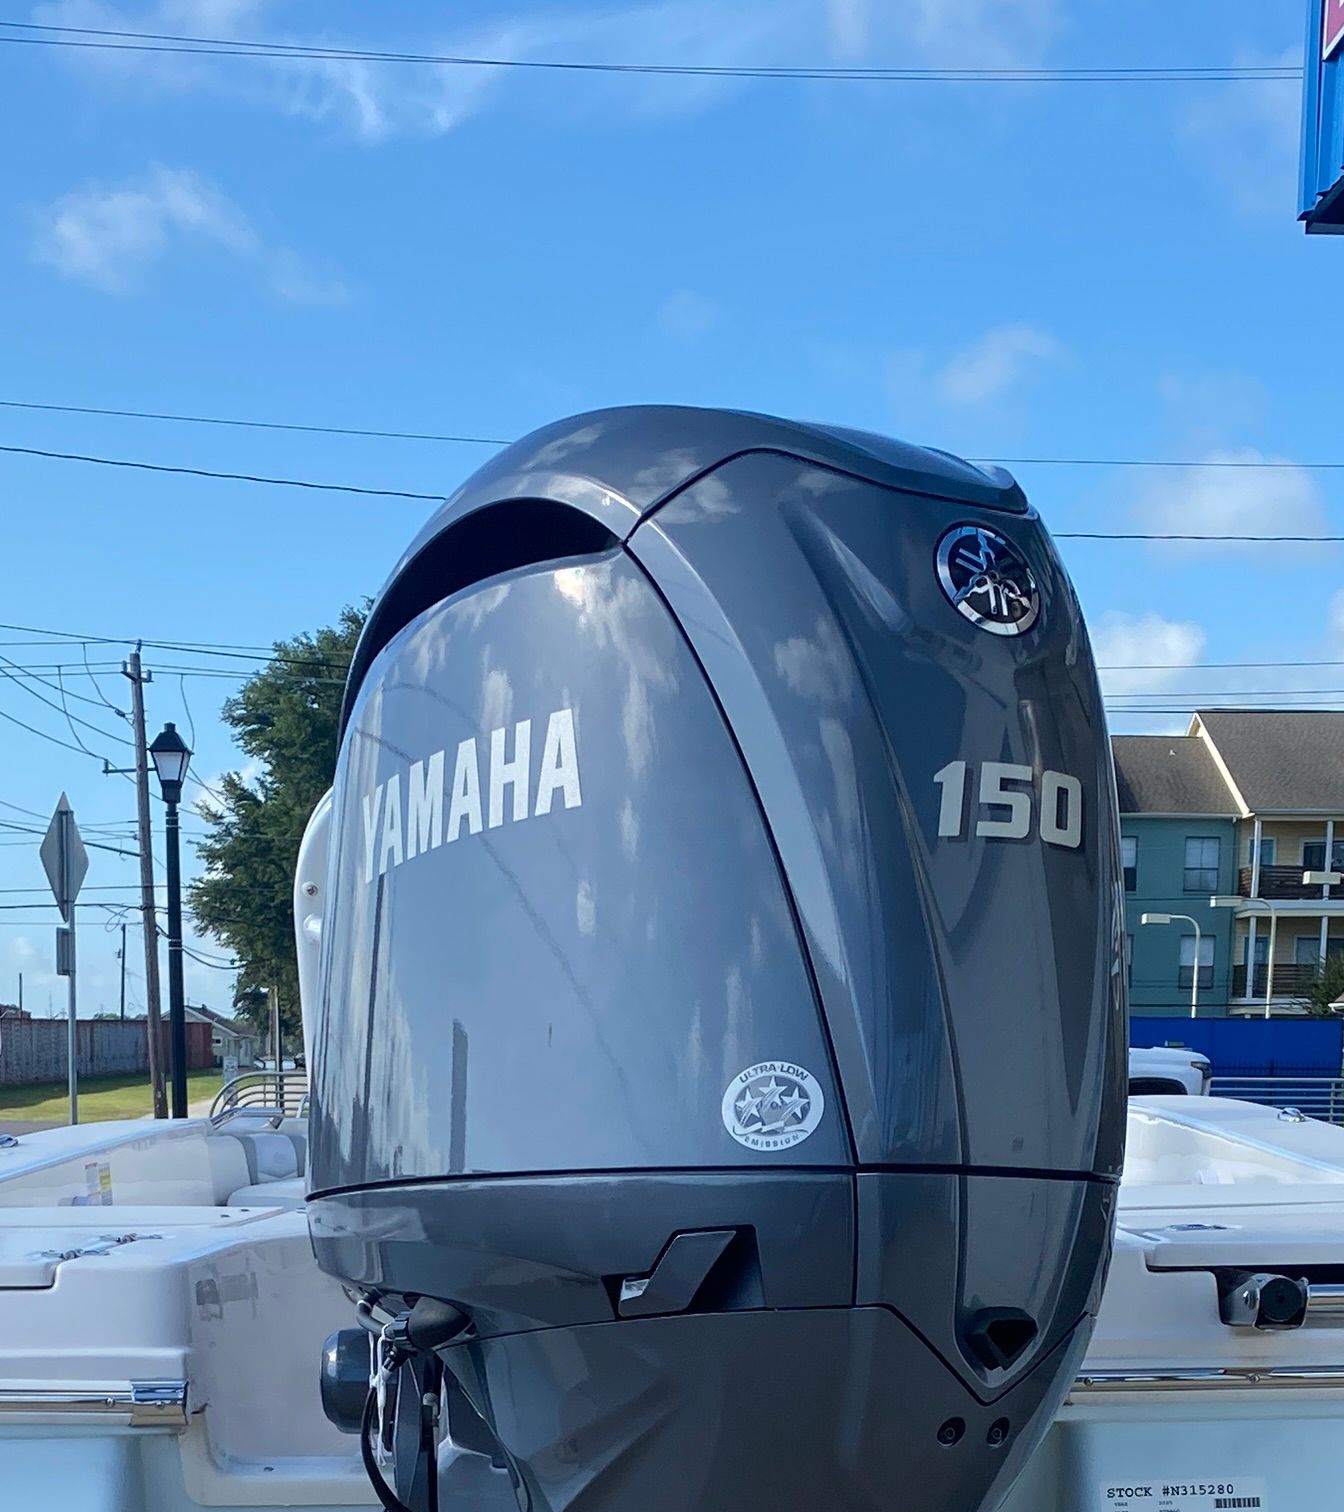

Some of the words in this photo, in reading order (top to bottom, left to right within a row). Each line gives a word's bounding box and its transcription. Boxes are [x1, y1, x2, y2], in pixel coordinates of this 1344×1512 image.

[363, 708, 582, 885] YAMAHA
[933, 761, 1082, 848] 150
[744, 1134, 799, 1148] EMISSION
[1106, 1486, 1153, 1499] STOCK
[1162, 1483, 1234, 1497] #N315280
